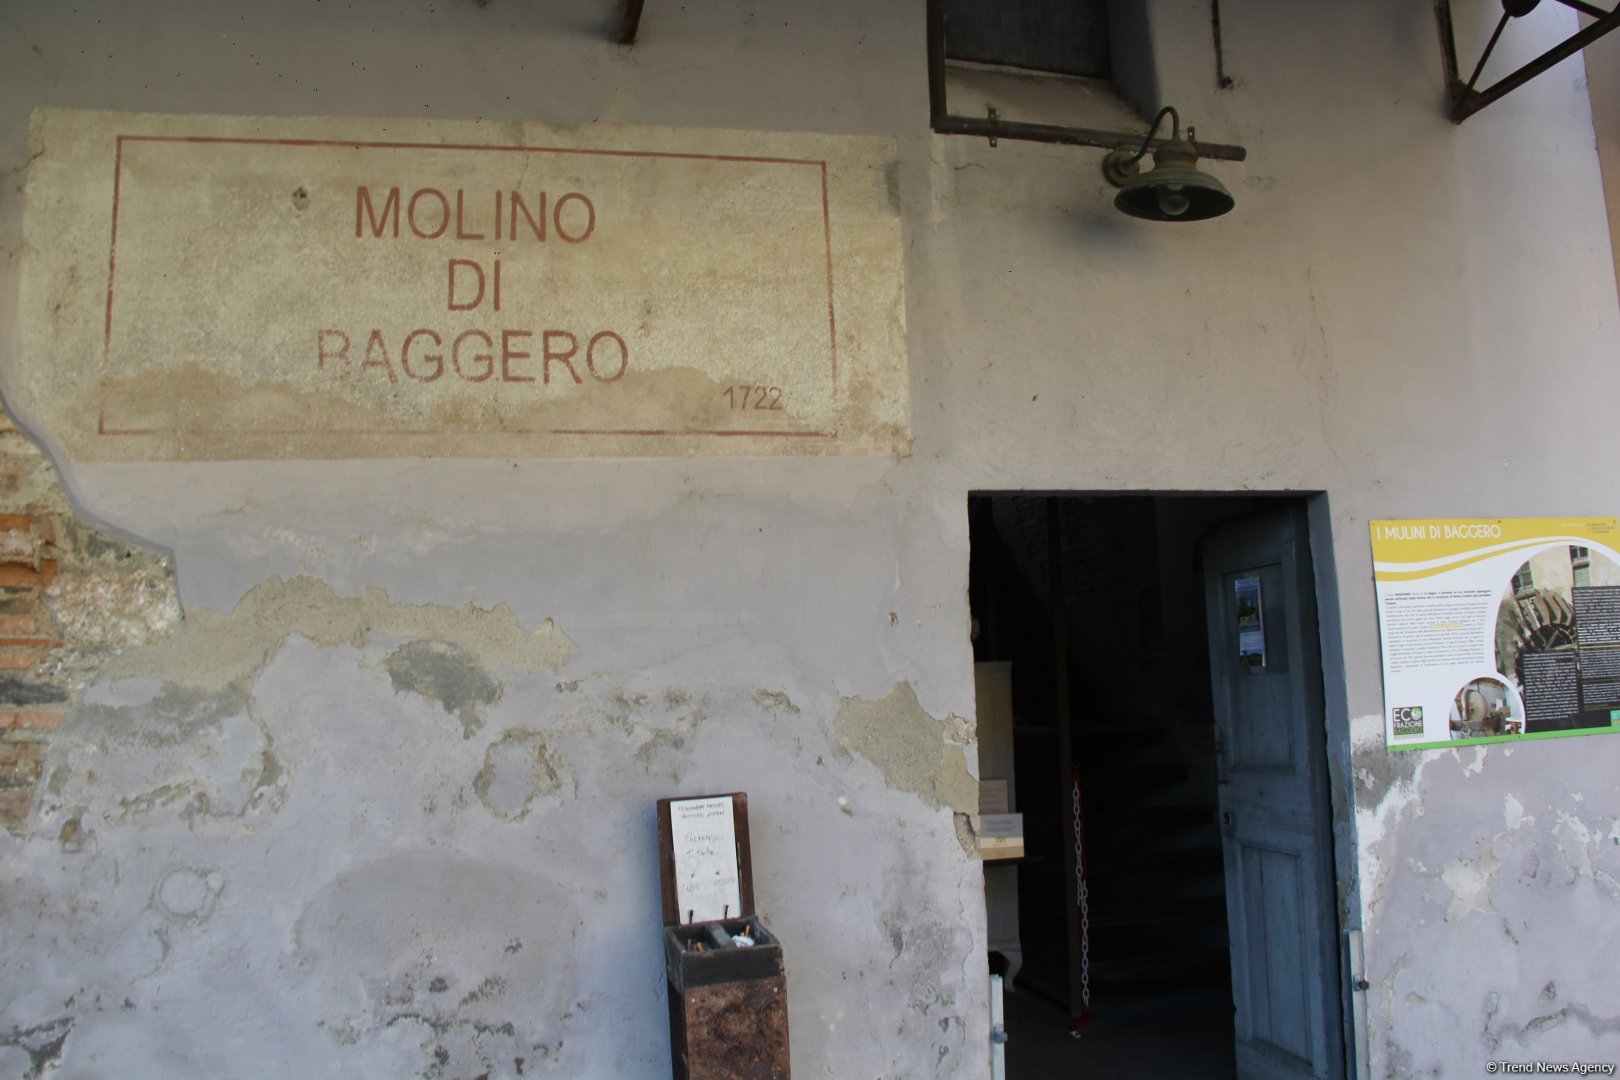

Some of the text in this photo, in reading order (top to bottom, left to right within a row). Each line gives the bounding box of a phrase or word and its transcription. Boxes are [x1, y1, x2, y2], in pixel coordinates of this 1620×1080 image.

[355, 186, 595, 244] MOLINO
[448, 259, 501, 311] DI
[318, 328, 628, 384] BAGGERO
[723, 385, 783, 410] 1722
[1377, 524, 1501, 540] I MULINI DI BAGGERO
[1393, 720, 1423, 729] FRAZIONE
